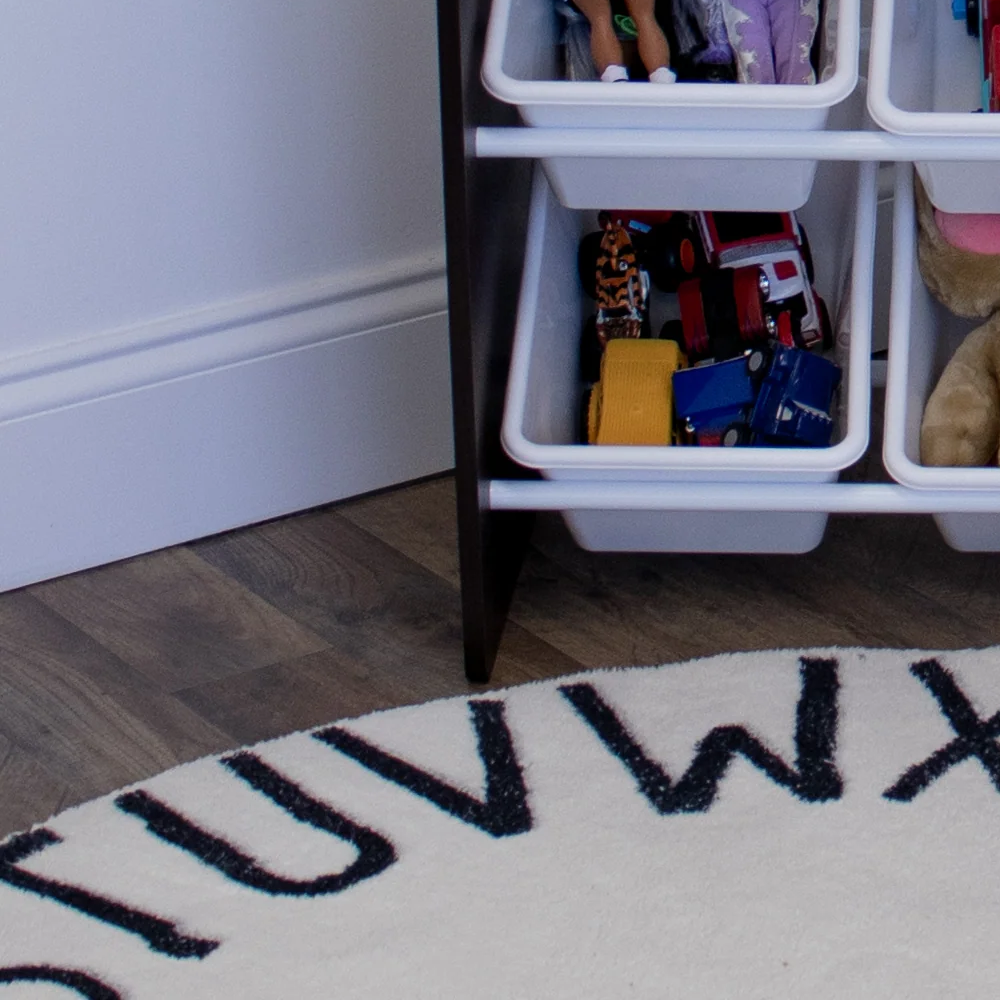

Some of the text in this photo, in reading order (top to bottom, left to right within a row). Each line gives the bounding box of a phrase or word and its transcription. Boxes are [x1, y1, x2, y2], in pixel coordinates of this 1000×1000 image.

[114, 750, 399, 897] U
[311, 698, 535, 838] V
[556, 656, 844, 815] W
